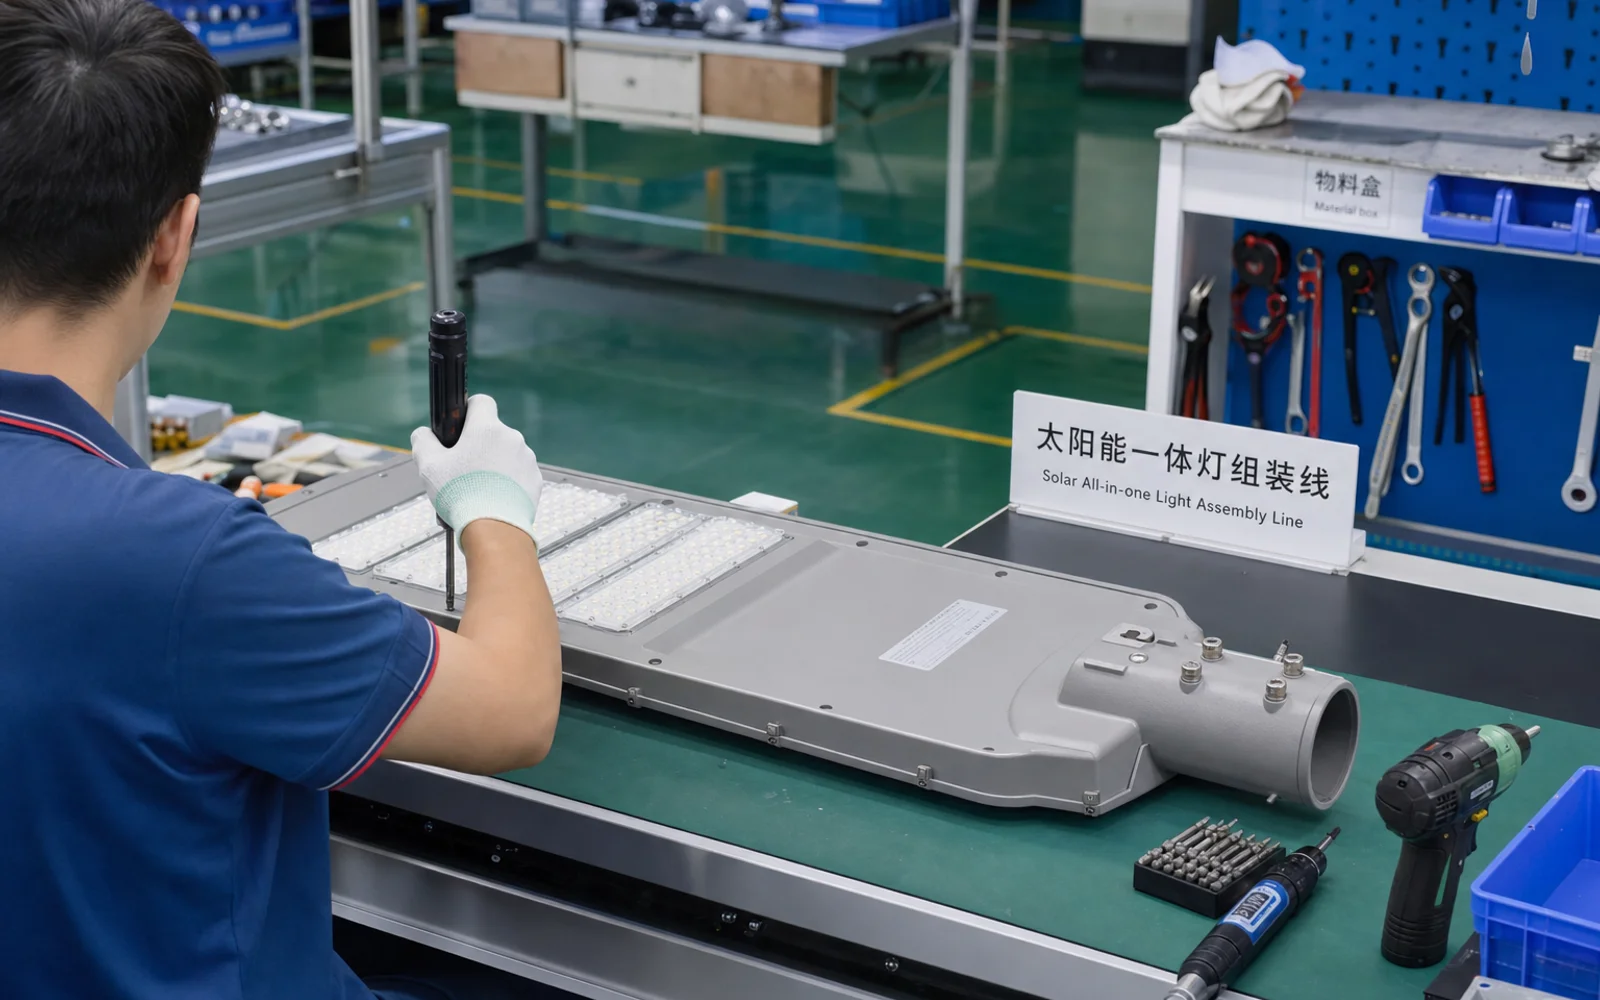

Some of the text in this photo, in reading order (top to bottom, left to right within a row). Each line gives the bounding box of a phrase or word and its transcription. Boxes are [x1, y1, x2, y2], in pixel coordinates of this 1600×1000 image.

[1314, 168, 1382, 198] 物料盒
[1314, 201, 1357, 215] Material
[1037, 421, 1330, 500] 太阳能一体灯组装线
[1042, 469, 1304, 529] Solar All-in-one Light Assembly Line
